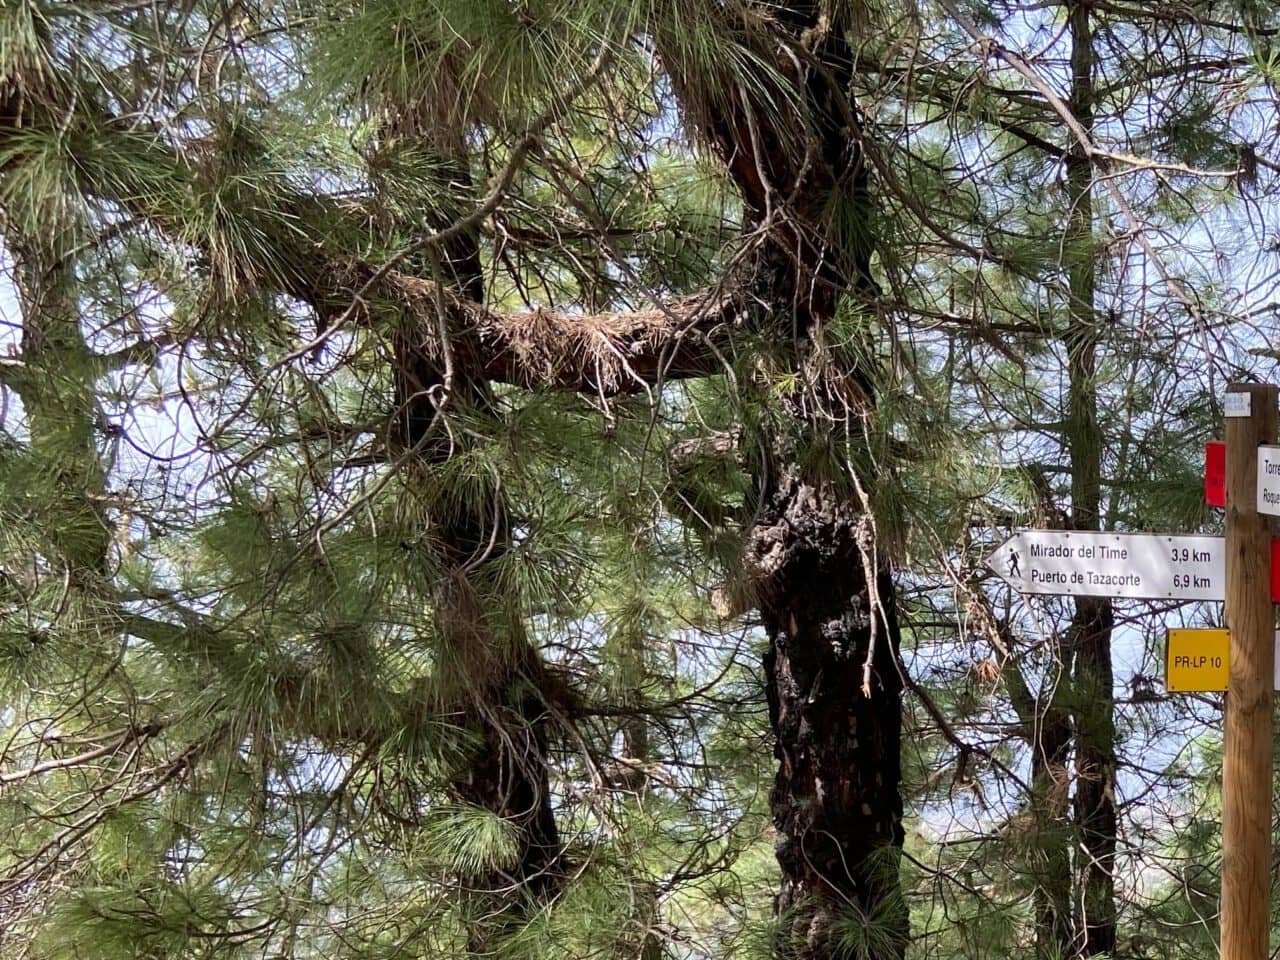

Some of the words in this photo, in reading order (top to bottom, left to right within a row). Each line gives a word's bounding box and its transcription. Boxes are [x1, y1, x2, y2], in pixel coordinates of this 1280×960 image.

[1265, 460, 1280, 476] Torre
[1263, 489, 1280, 506] Roque
[1030, 543, 1075, 559] Mirador
[1078, 545, 1096, 559] del
[1099, 546, 1128, 560] Time
[1171, 549, 1190, 563] 3,9
[1192, 549, 1211, 563] km
[1031, 569, 1067, 584] Puerto
[1070, 571, 1084, 584] de
[1087, 571, 1141, 586] Tazacorte
[1173, 574, 1190, 589] 6,9
[1193, 574, 1211, 588] km
[1175, 656, 1207, 668] PR-LP
[1210, 656, 1222, 668] 10
